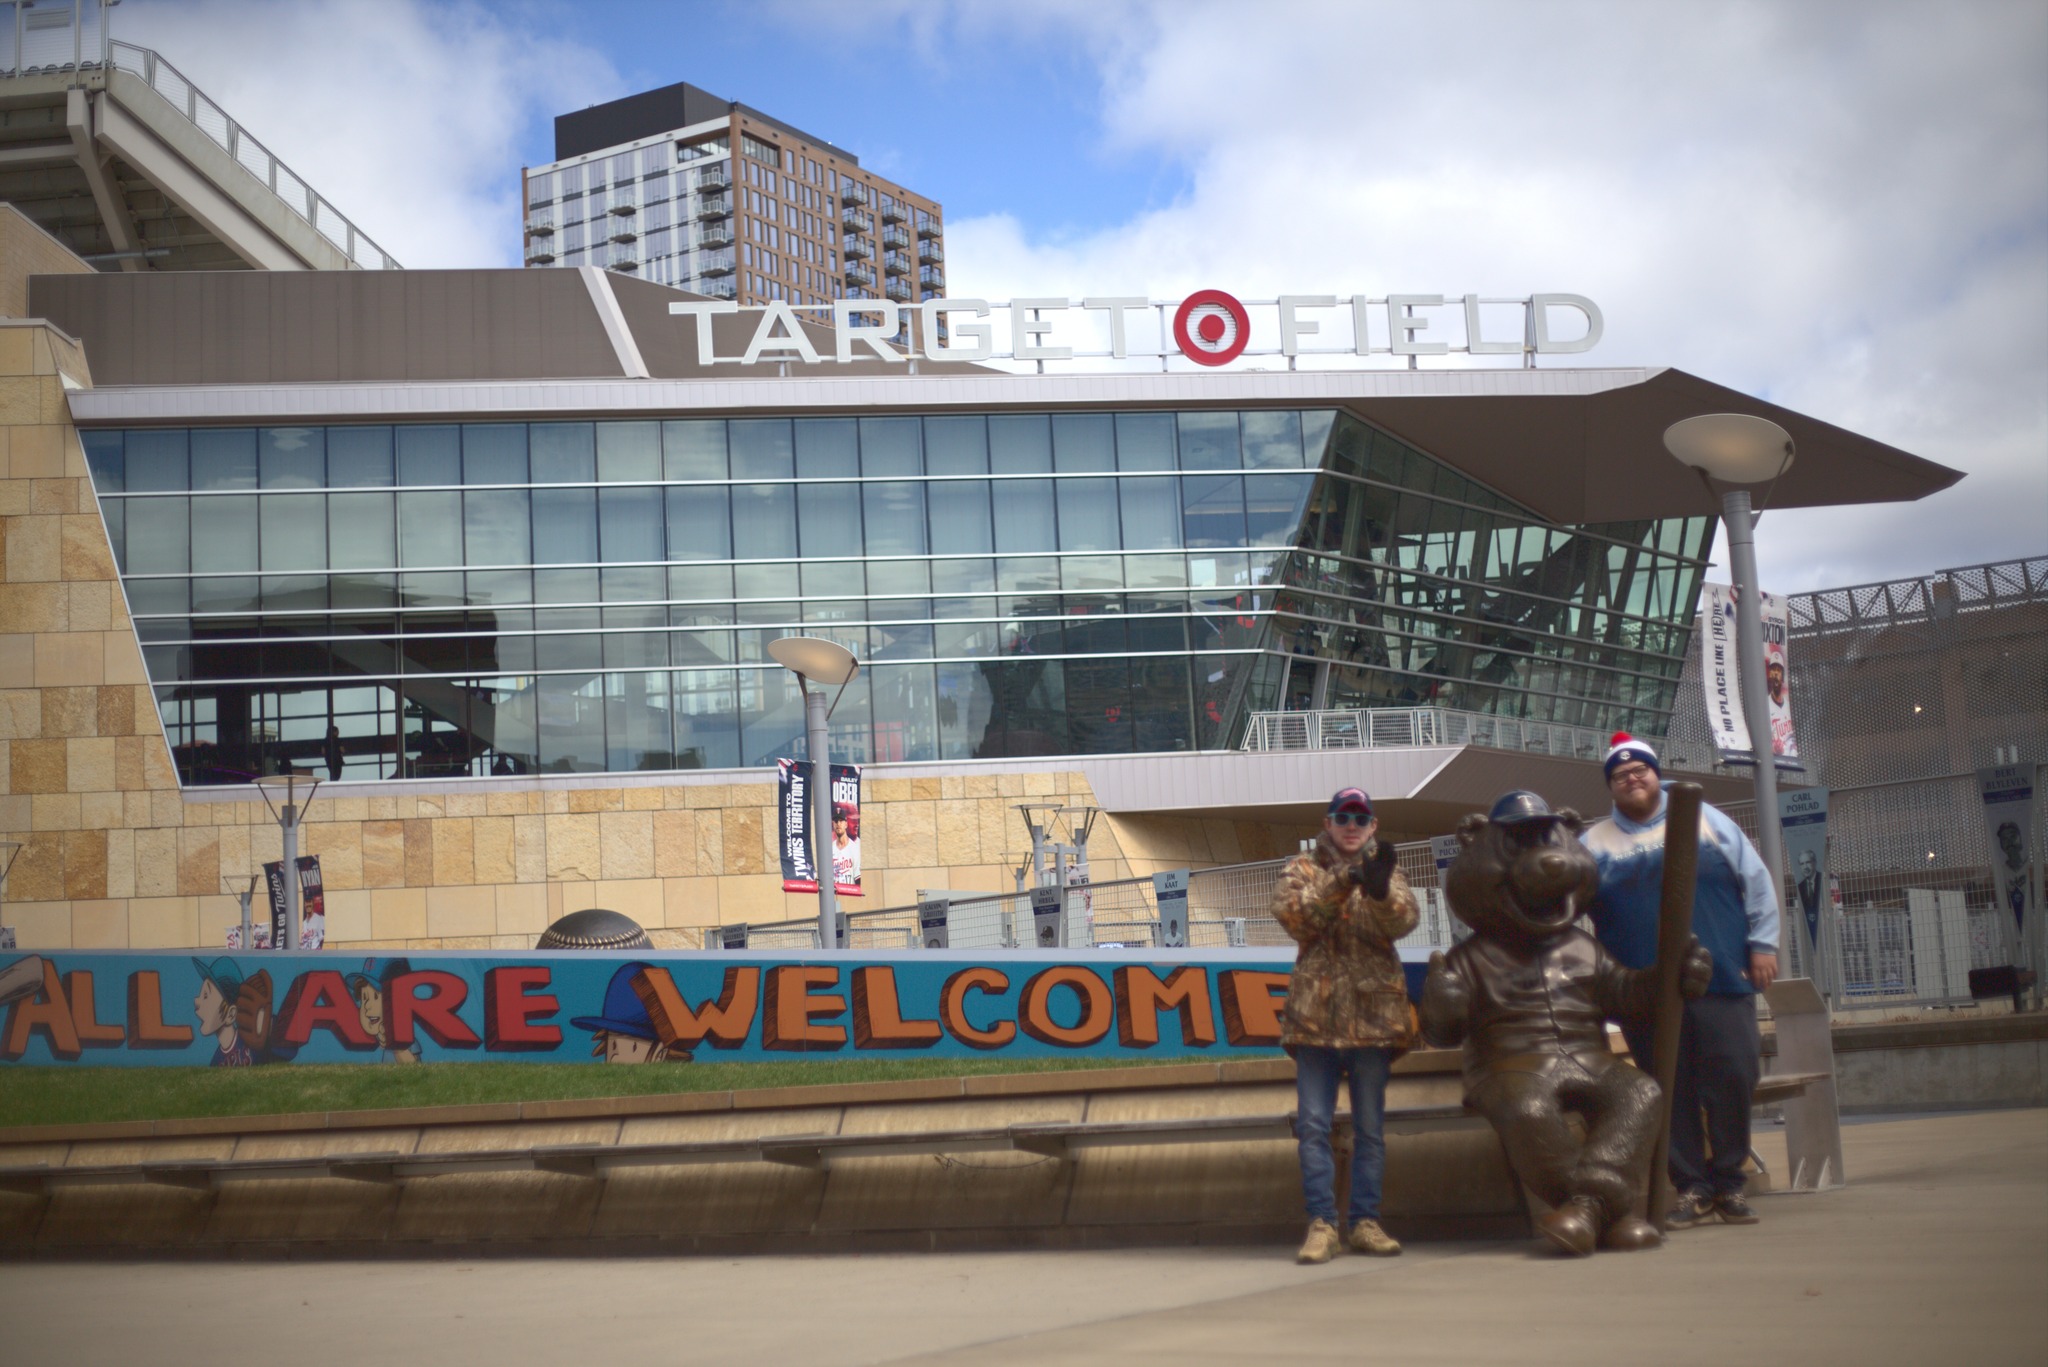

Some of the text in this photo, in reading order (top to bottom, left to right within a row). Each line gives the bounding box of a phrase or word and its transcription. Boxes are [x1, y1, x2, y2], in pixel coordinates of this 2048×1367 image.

[669, 294, 1604, 365] TARGET FIELD
[1714, 644, 1724, 666] LIKE
[1715, 668, 1730, 715] PLACE
[1723, 716, 1734, 732] NO
[1995, 767, 2017, 778] BERT
[832, 781, 858, 804] OBER
[1792, 792, 1812, 802] CARL
[792, 774, 804, 834] TERRITORY
[1786, 801, 1819, 813] POHLAD
[792, 838, 807, 877] TWINS
[1166, 873, 1175, 881] JIM
[2, 958, 1291, 1061] ALL ARE WELCOME
